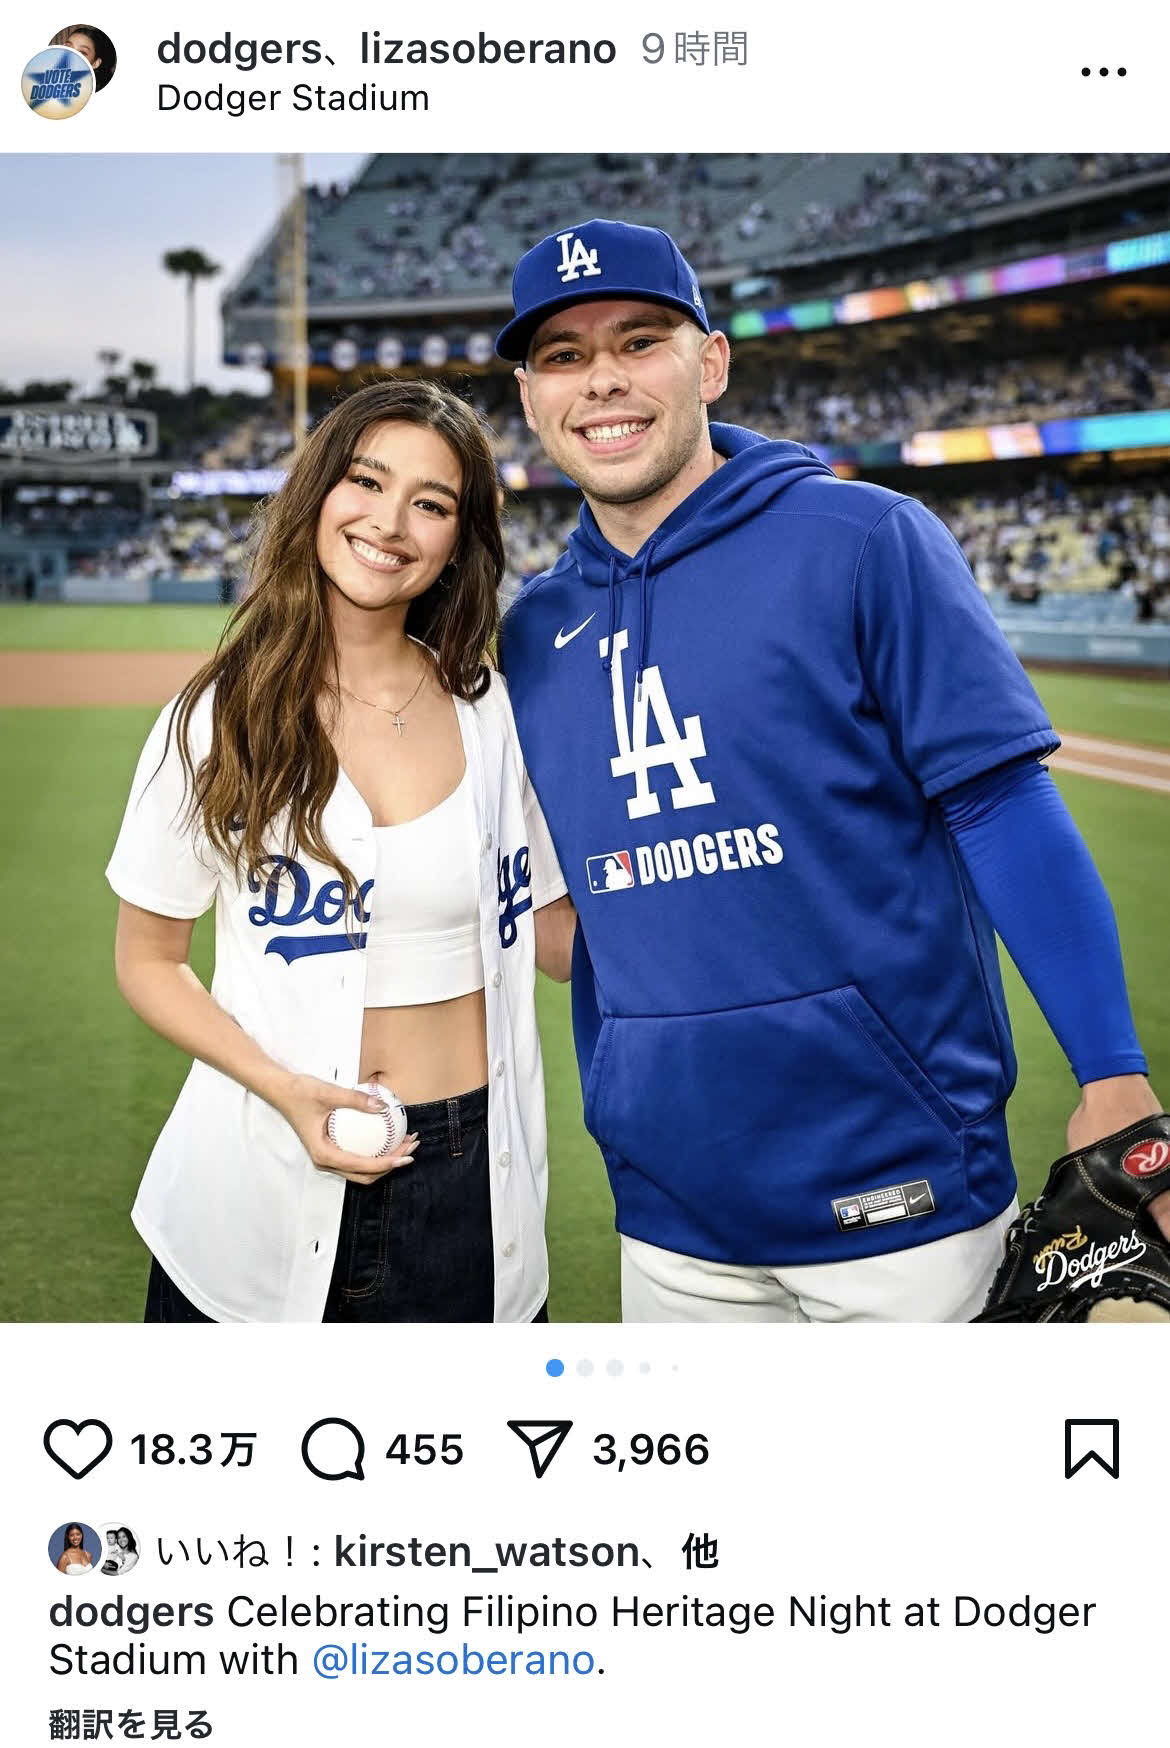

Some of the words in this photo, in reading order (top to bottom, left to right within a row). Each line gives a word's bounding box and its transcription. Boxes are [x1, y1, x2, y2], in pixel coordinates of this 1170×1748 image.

[556, 232, 601, 283] LA
[599, 628, 716, 820] LA
[635, 823, 784, 886] DODGERS
[1035, 1229, 1147, 1292] Dodgers
